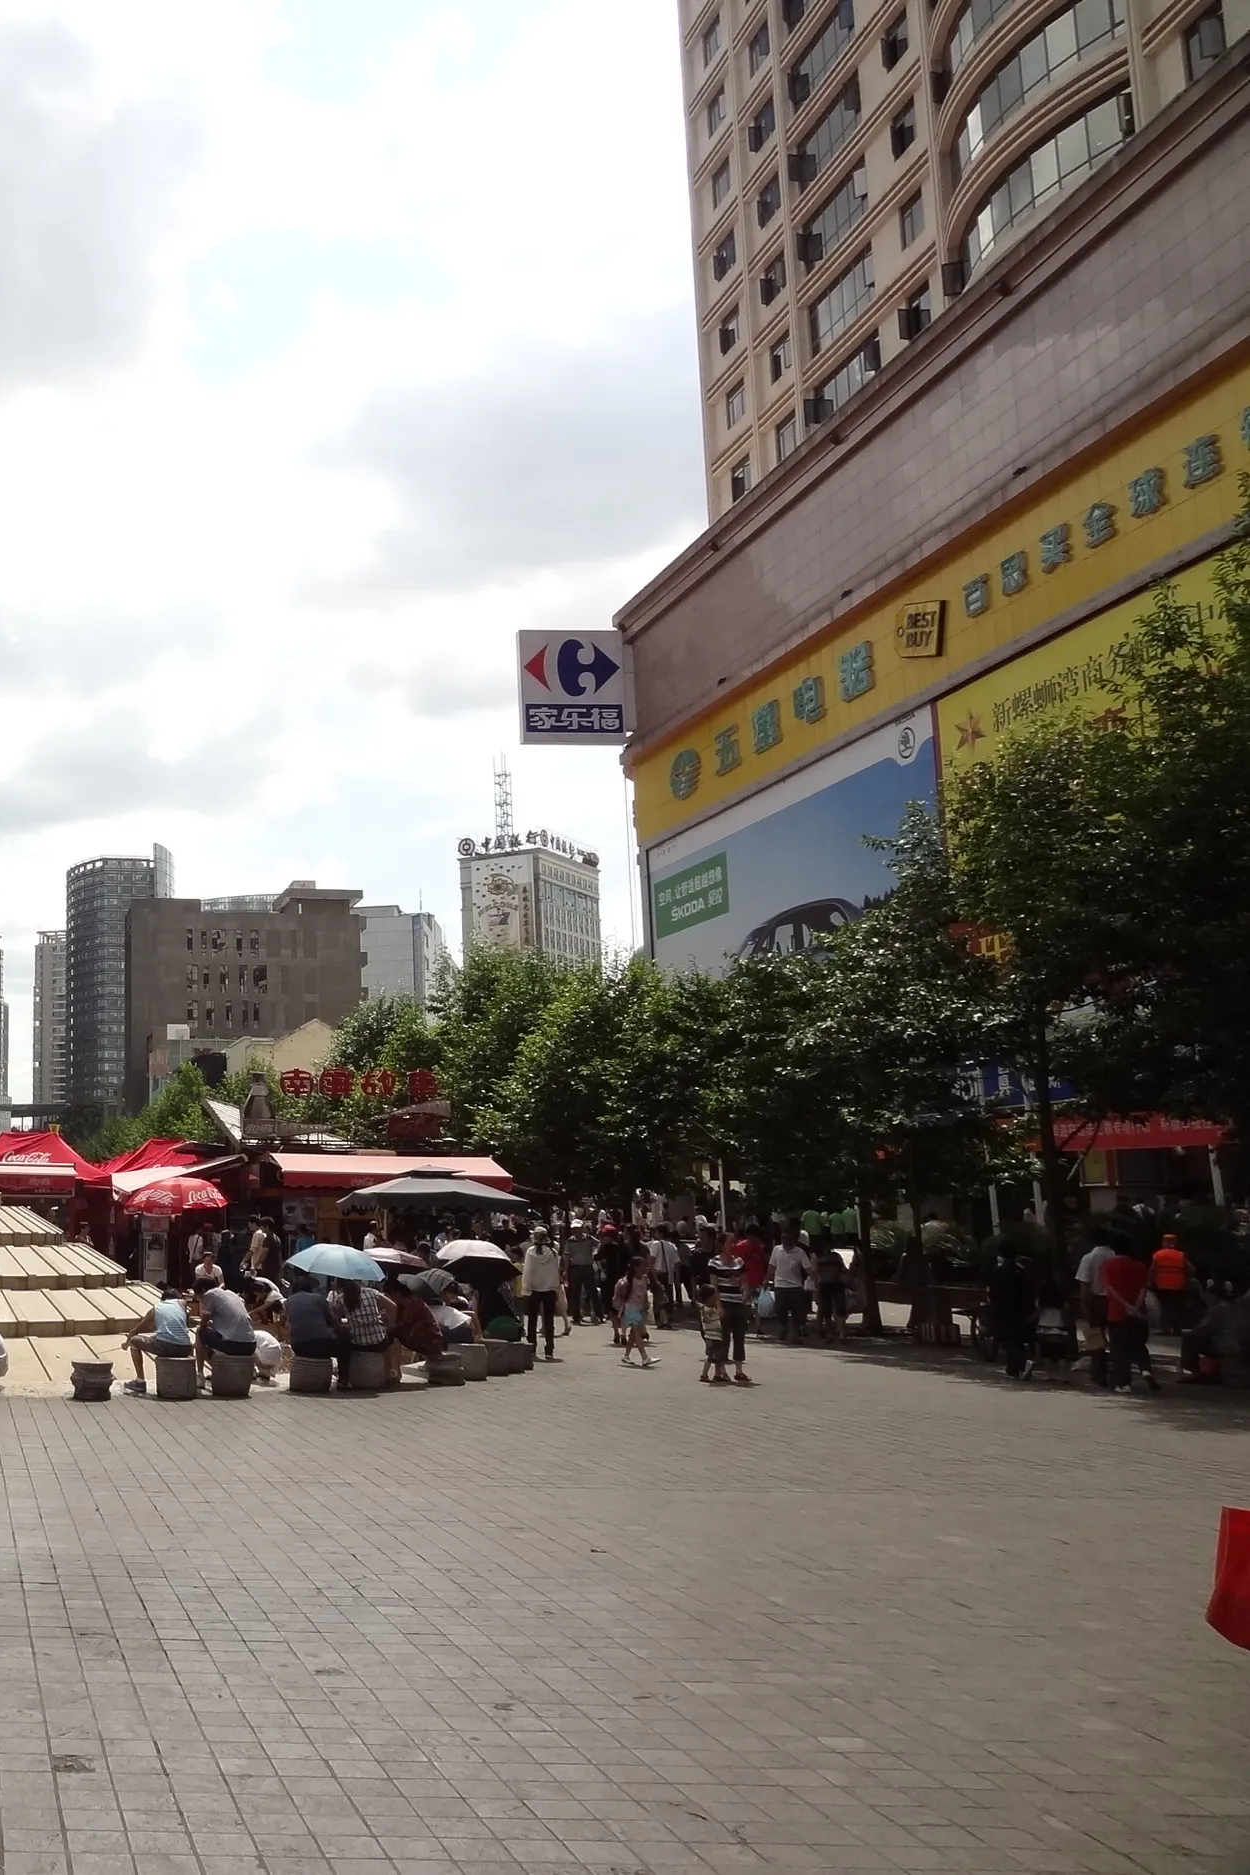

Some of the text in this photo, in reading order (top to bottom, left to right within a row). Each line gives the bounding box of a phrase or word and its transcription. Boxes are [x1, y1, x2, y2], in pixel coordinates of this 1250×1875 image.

[906, 611, 937, 629] BEST
[905, 631, 932, 648] BUY
[529, 706, 620, 730] 家乐福
[714, 640, 876, 777] 五星电器
[481, 830, 539, 853] 中国银行
